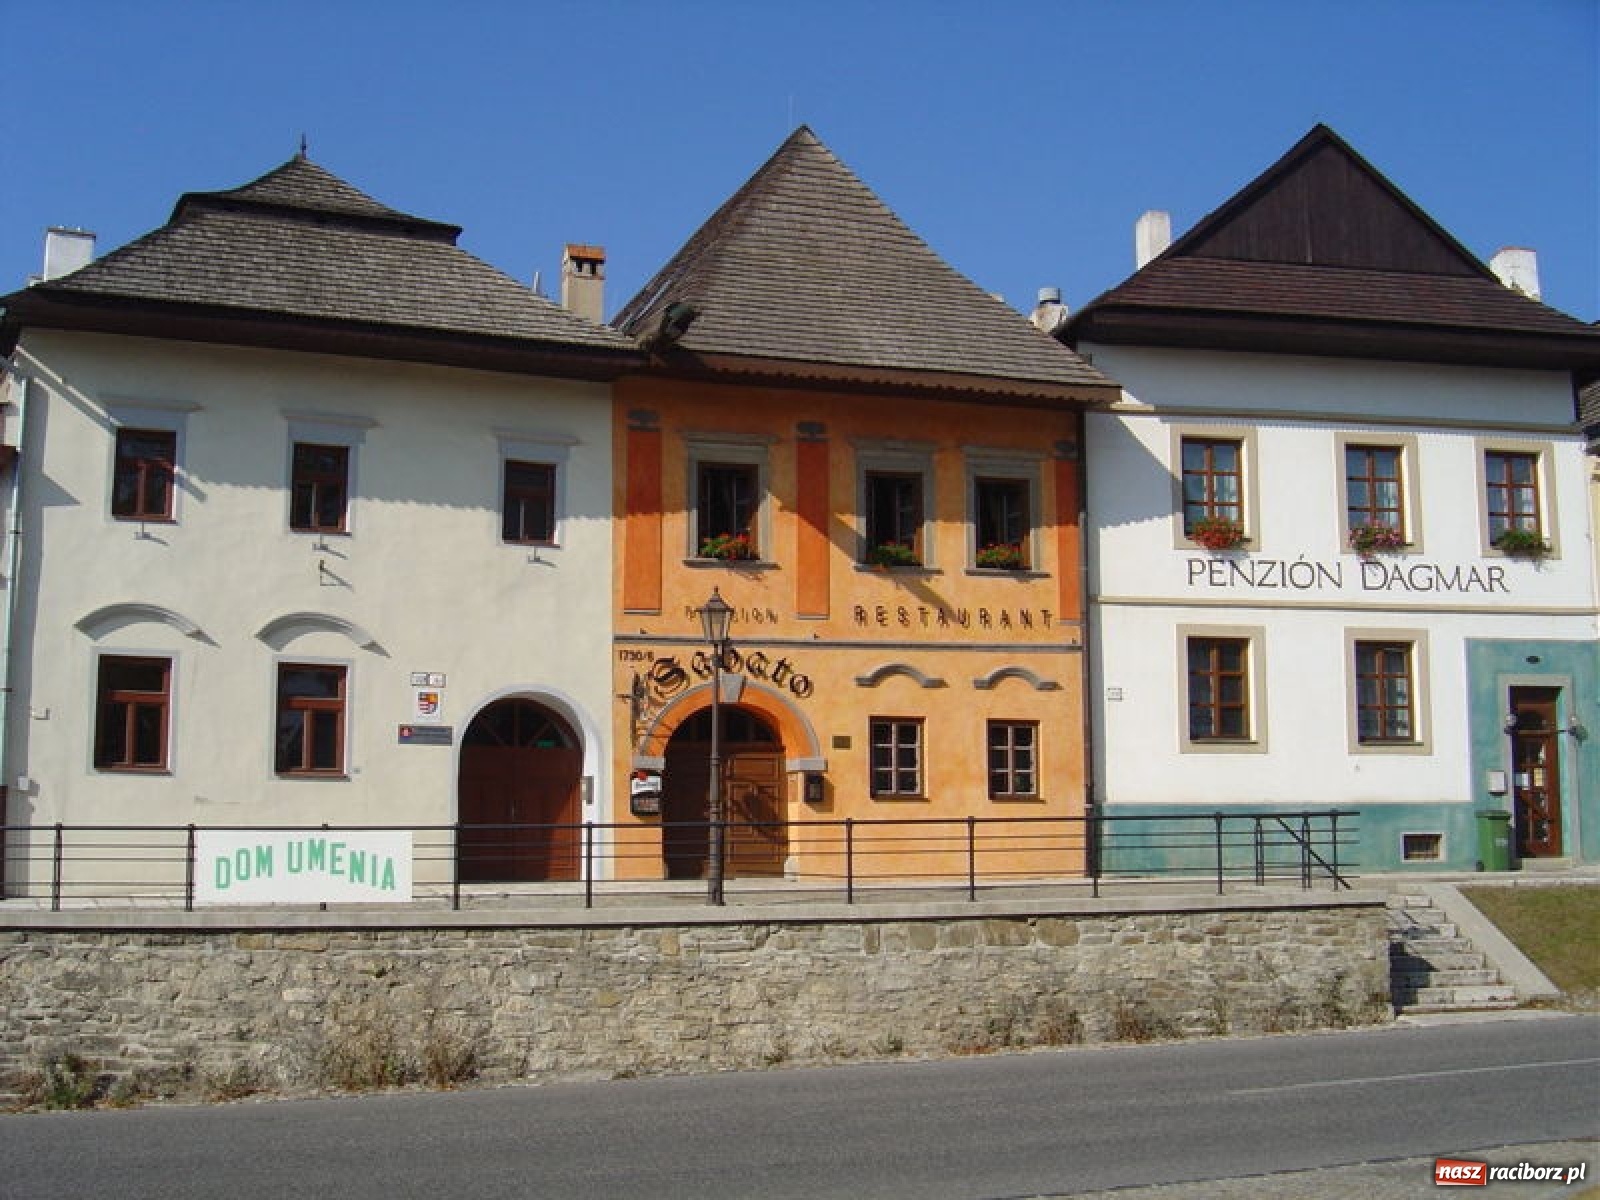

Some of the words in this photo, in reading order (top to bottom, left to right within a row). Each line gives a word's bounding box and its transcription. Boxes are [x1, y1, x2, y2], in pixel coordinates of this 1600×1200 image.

[1187, 554, 1342, 589] PENZIÓN
[1359, 561, 1510, 593] DAGMAR
[853, 605, 1052, 629] RESTAURANT
[215, 845, 273, 890] DOM
[287, 838, 395, 891] UMENIA
